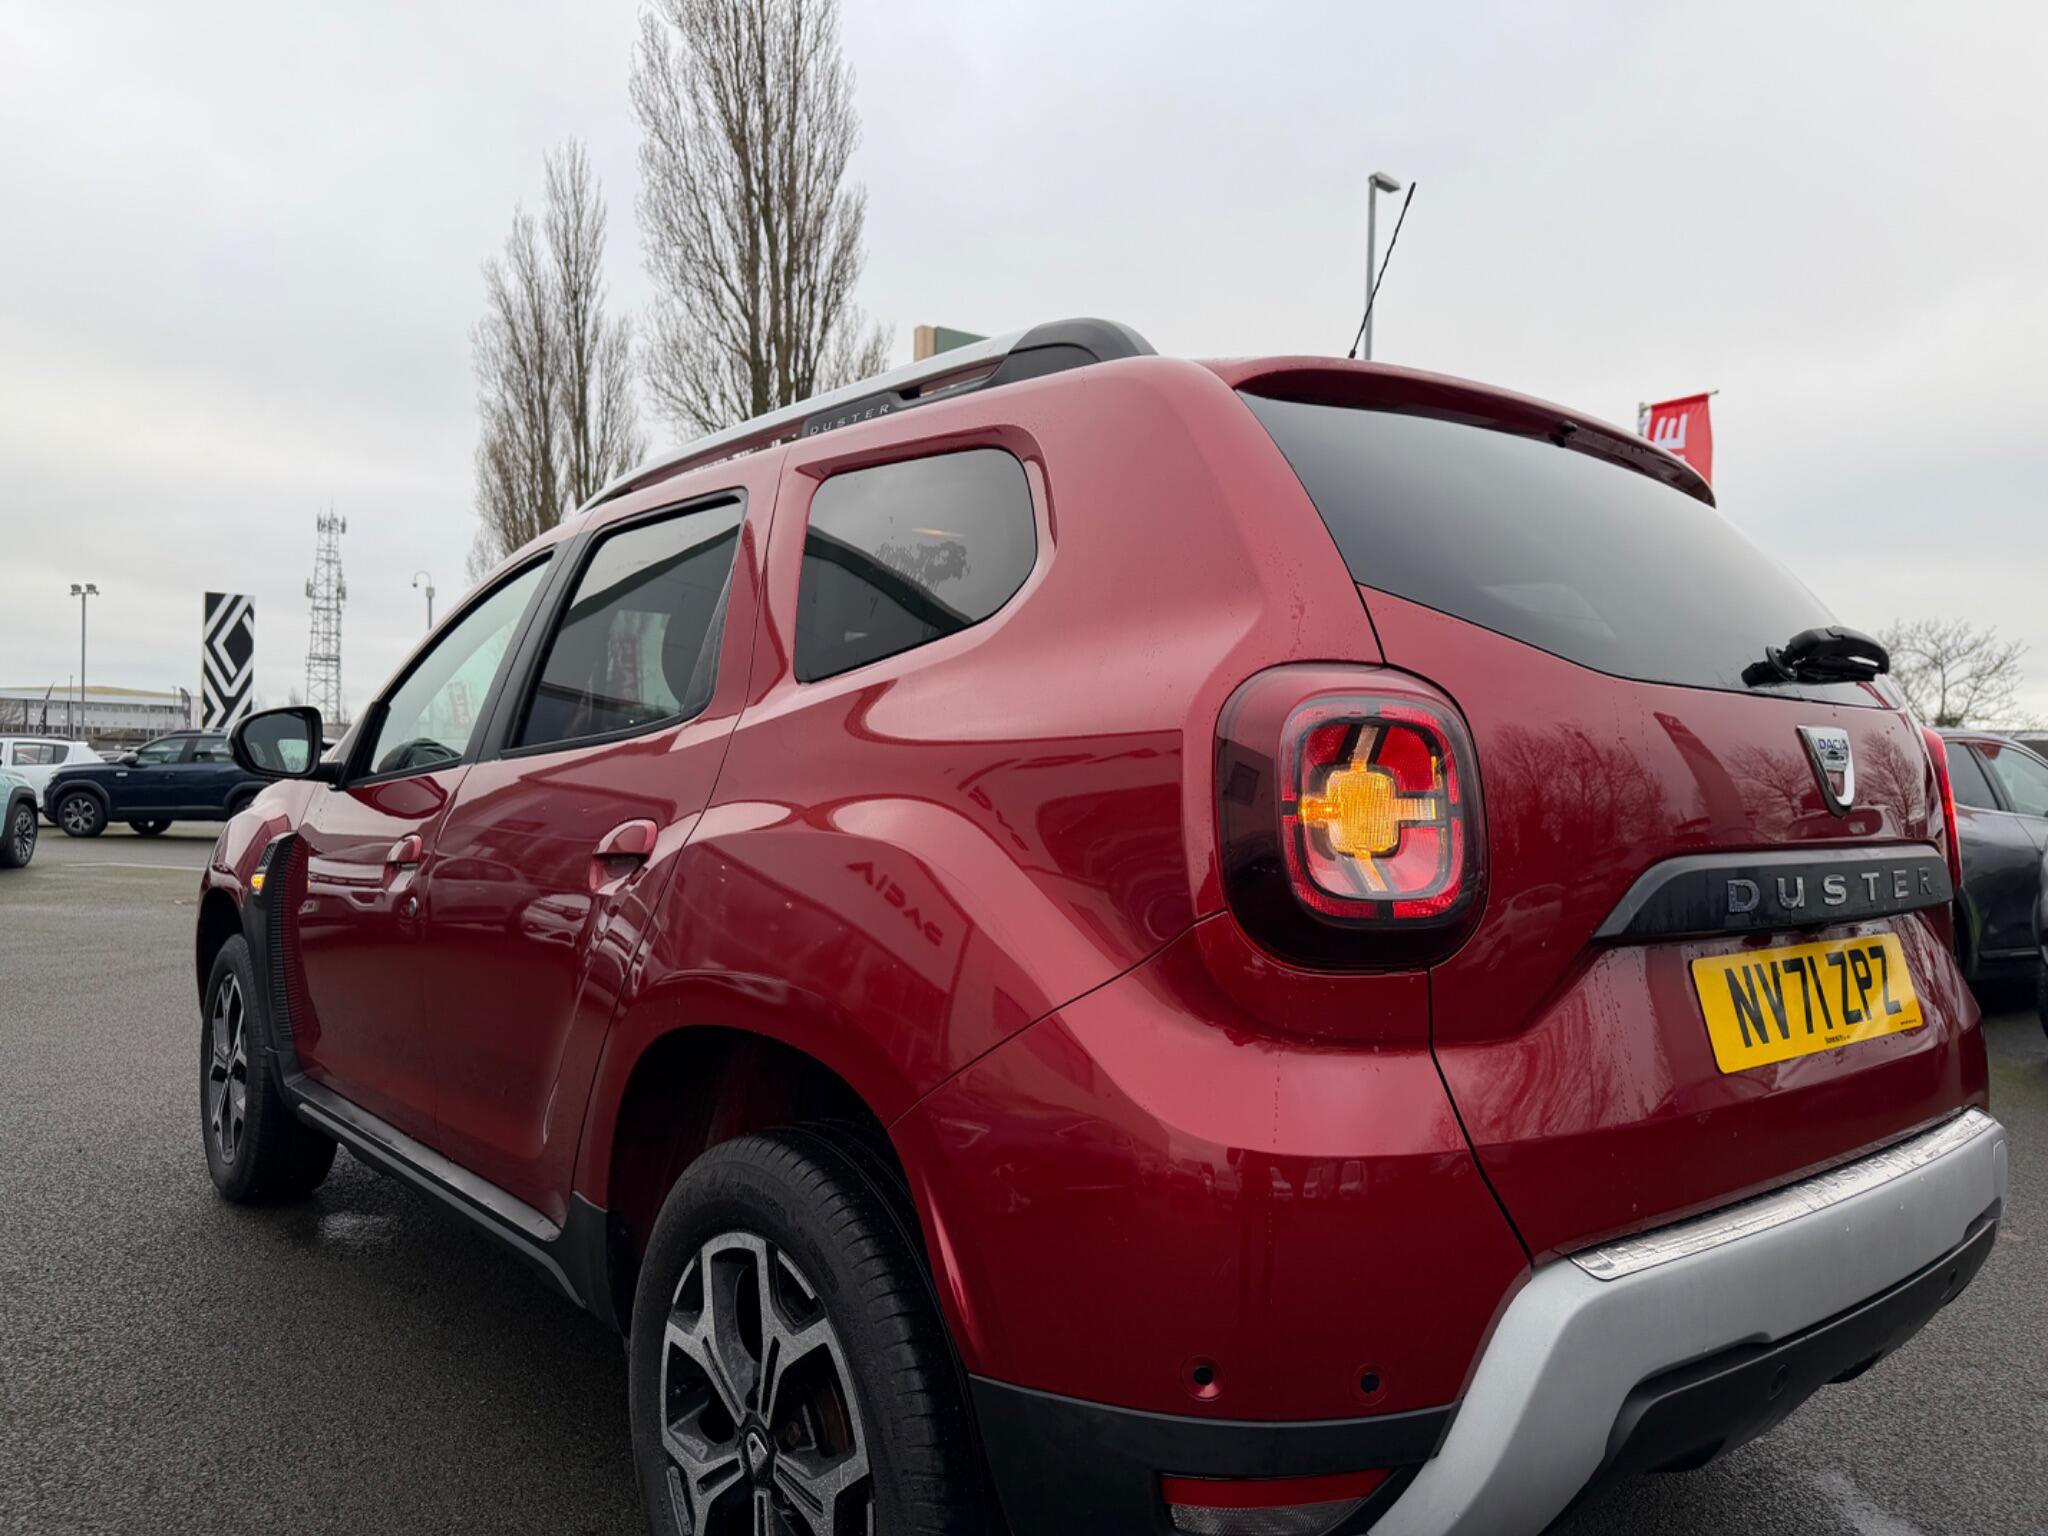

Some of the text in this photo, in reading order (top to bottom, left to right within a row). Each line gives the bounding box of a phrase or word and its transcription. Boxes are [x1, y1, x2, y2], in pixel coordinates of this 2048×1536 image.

[809, 403, 890, 436] DUSTER
[1817, 738, 1849, 751] DACIA
[1727, 866, 1934, 914] DUSTER
[1723, 944, 1903, 1049] NV71 ZPZ
